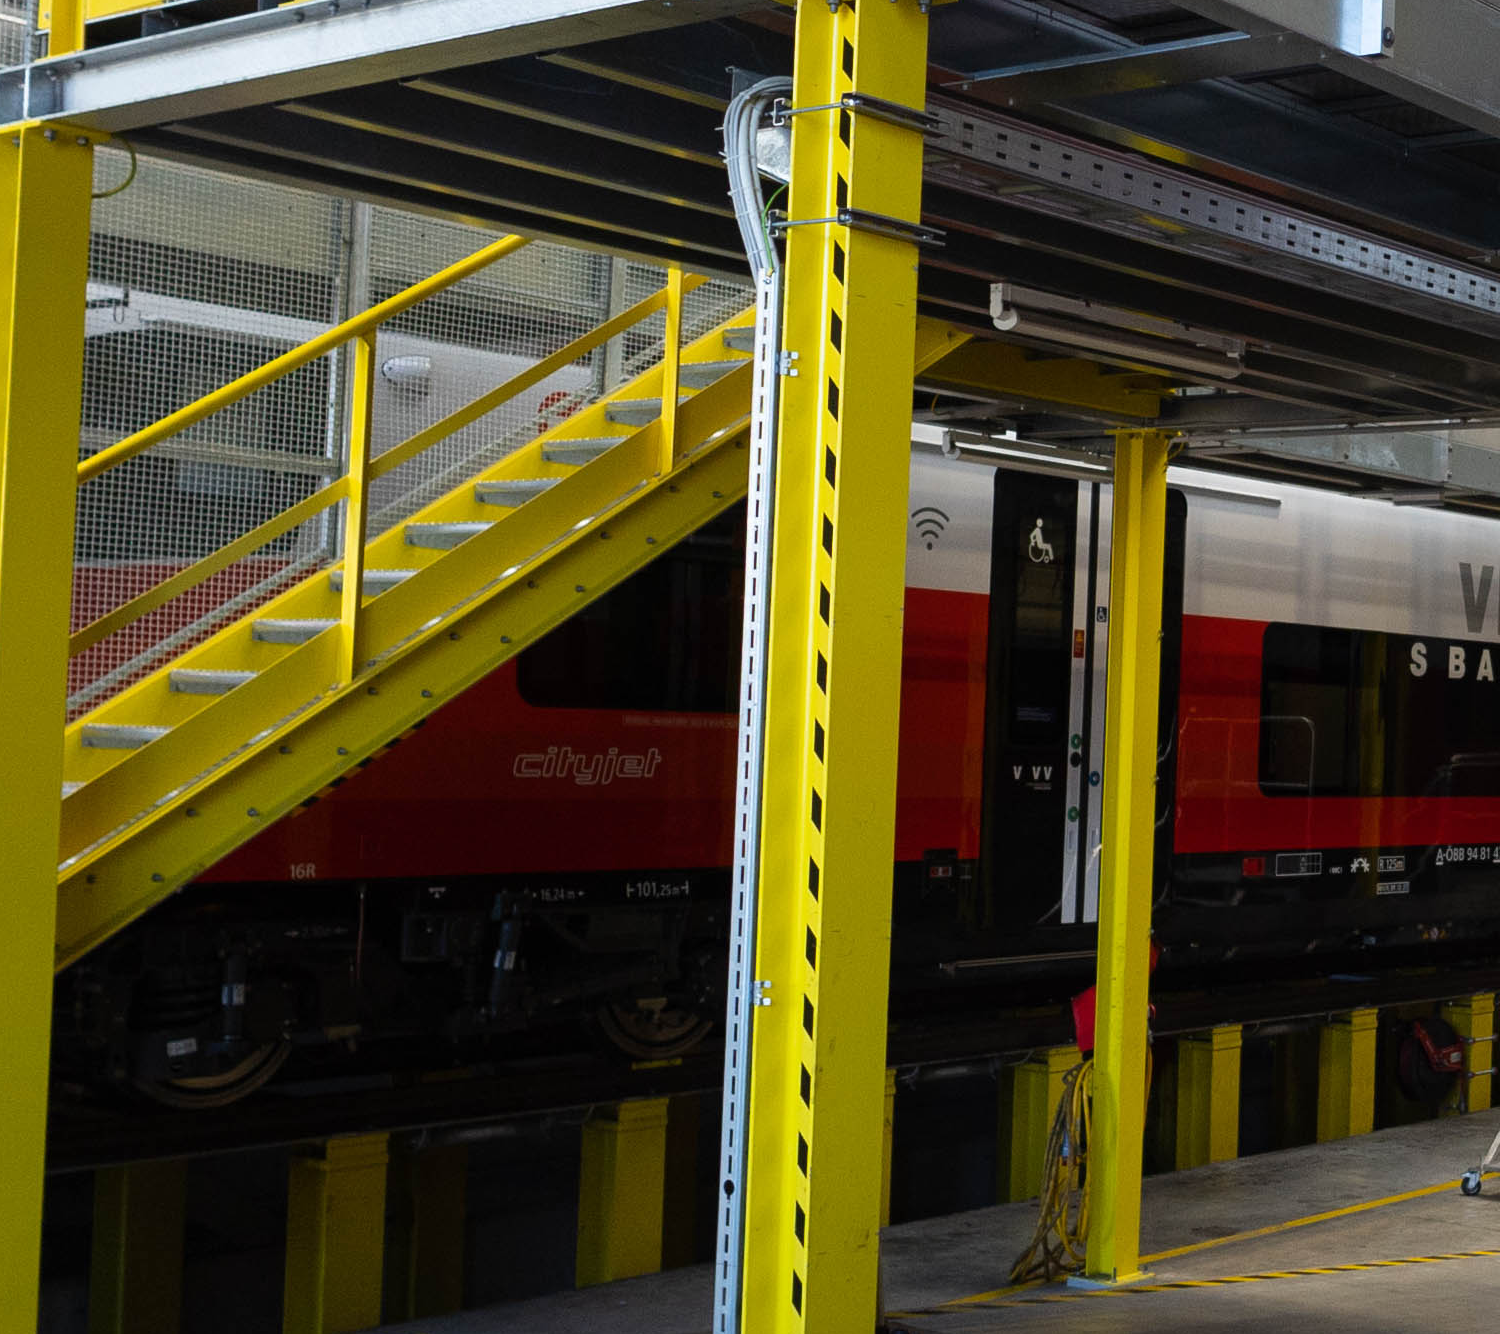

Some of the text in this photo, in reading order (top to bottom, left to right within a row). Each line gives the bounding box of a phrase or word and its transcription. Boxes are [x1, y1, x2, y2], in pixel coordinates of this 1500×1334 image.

[513, 746, 662, 786] cityjet
[1466, 847, 1478, 861] 94
[1479, 846, 1490, 861] 81
[289, 862, 316, 879] 16R
